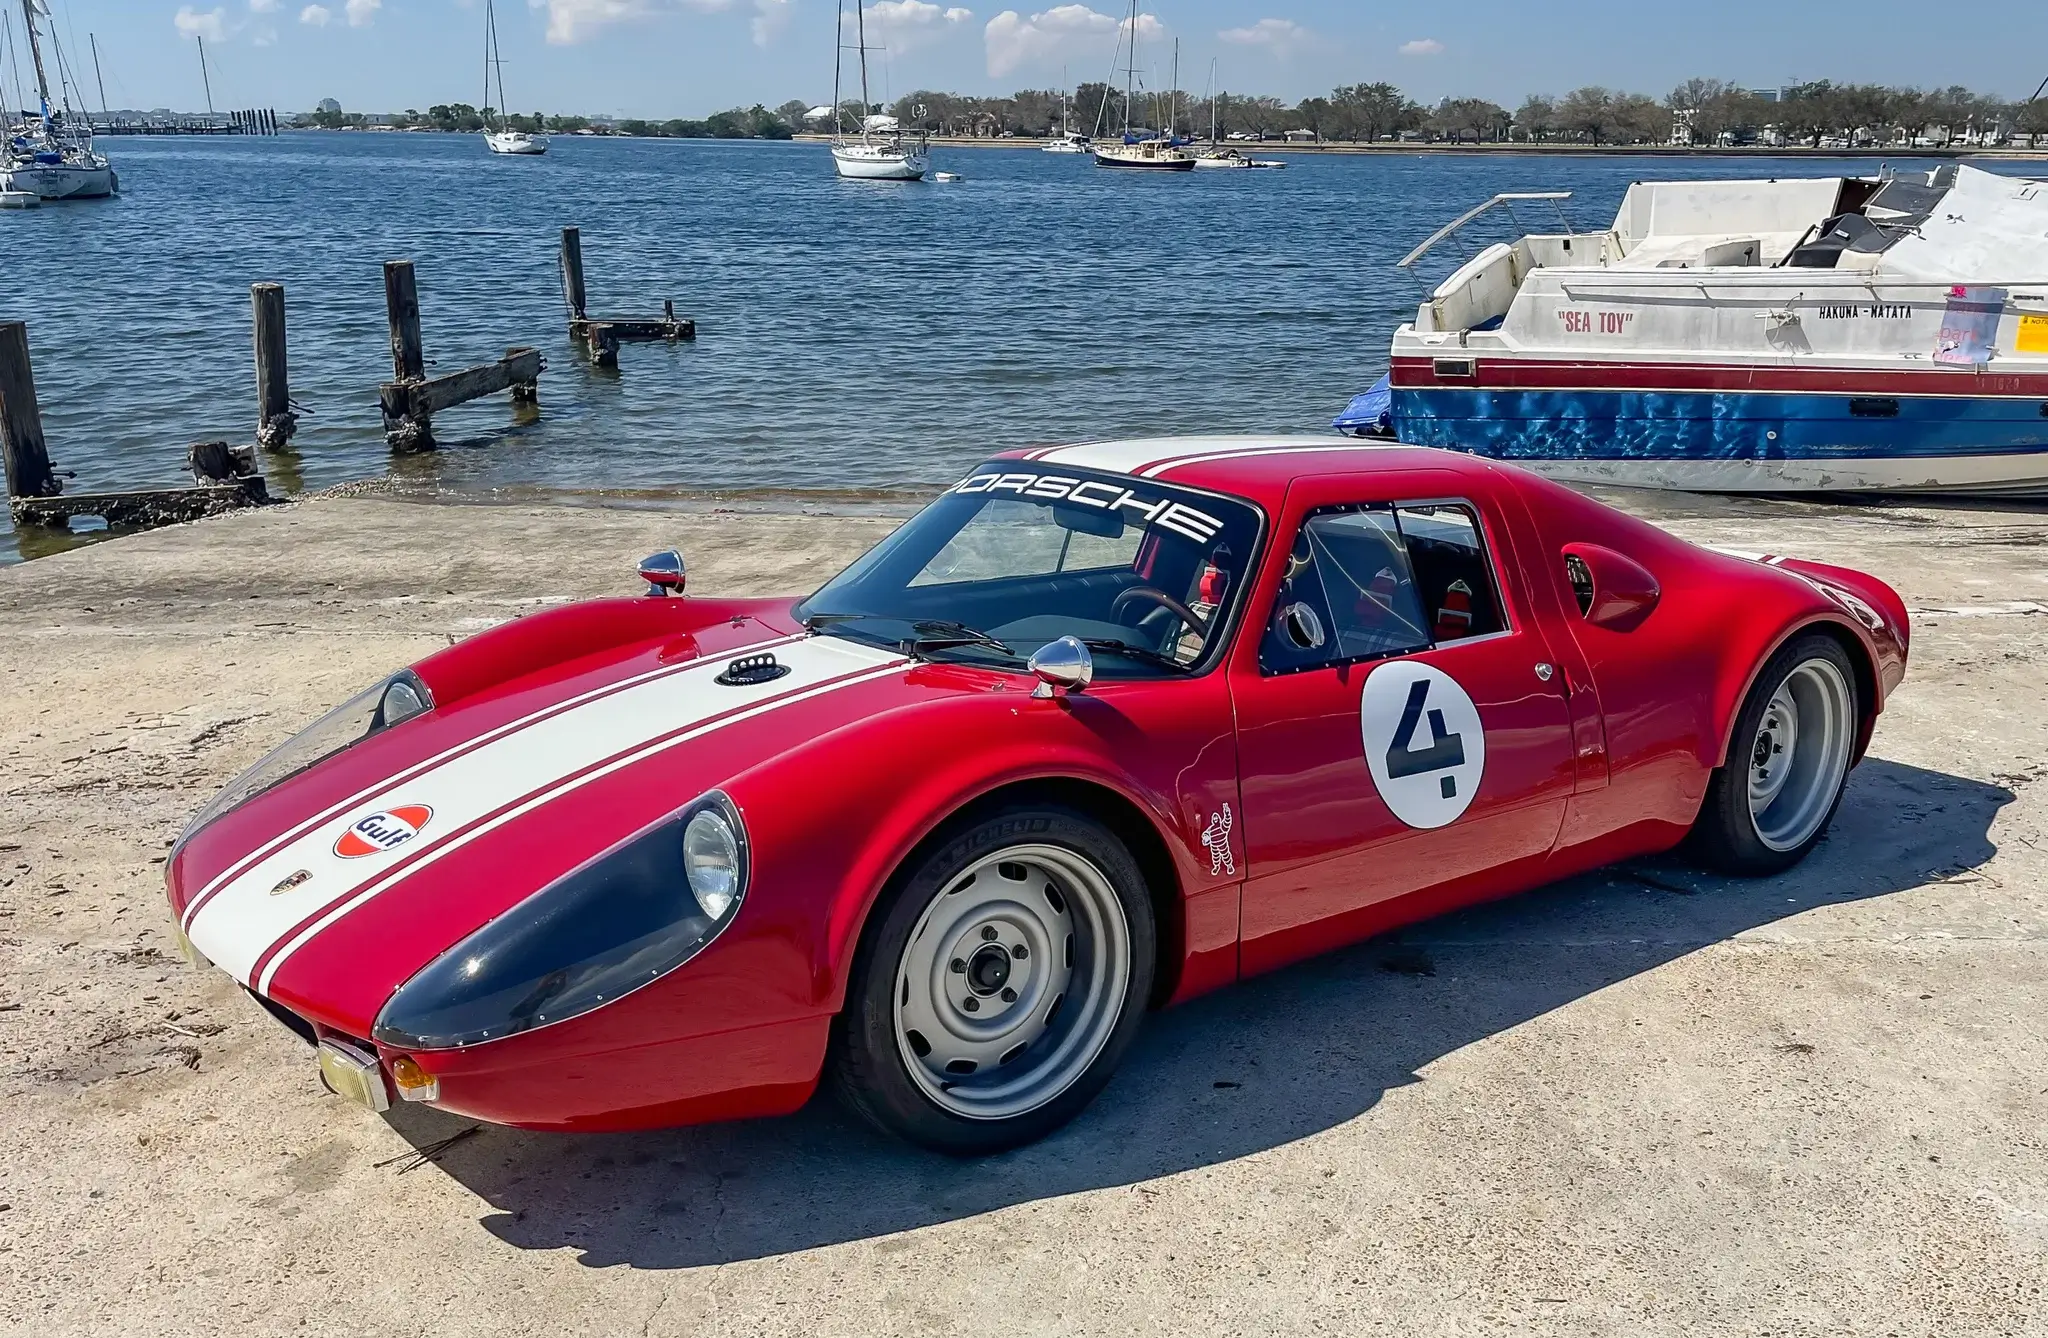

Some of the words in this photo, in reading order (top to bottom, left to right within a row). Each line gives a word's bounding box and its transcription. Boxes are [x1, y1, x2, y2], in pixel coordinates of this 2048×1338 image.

[1558, 311, 1591, 332] "SEA
[1599, 312, 1633, 333] TOY"
[1385, 679, 1465, 799] 4
[356, 815, 412, 847] Gulf
